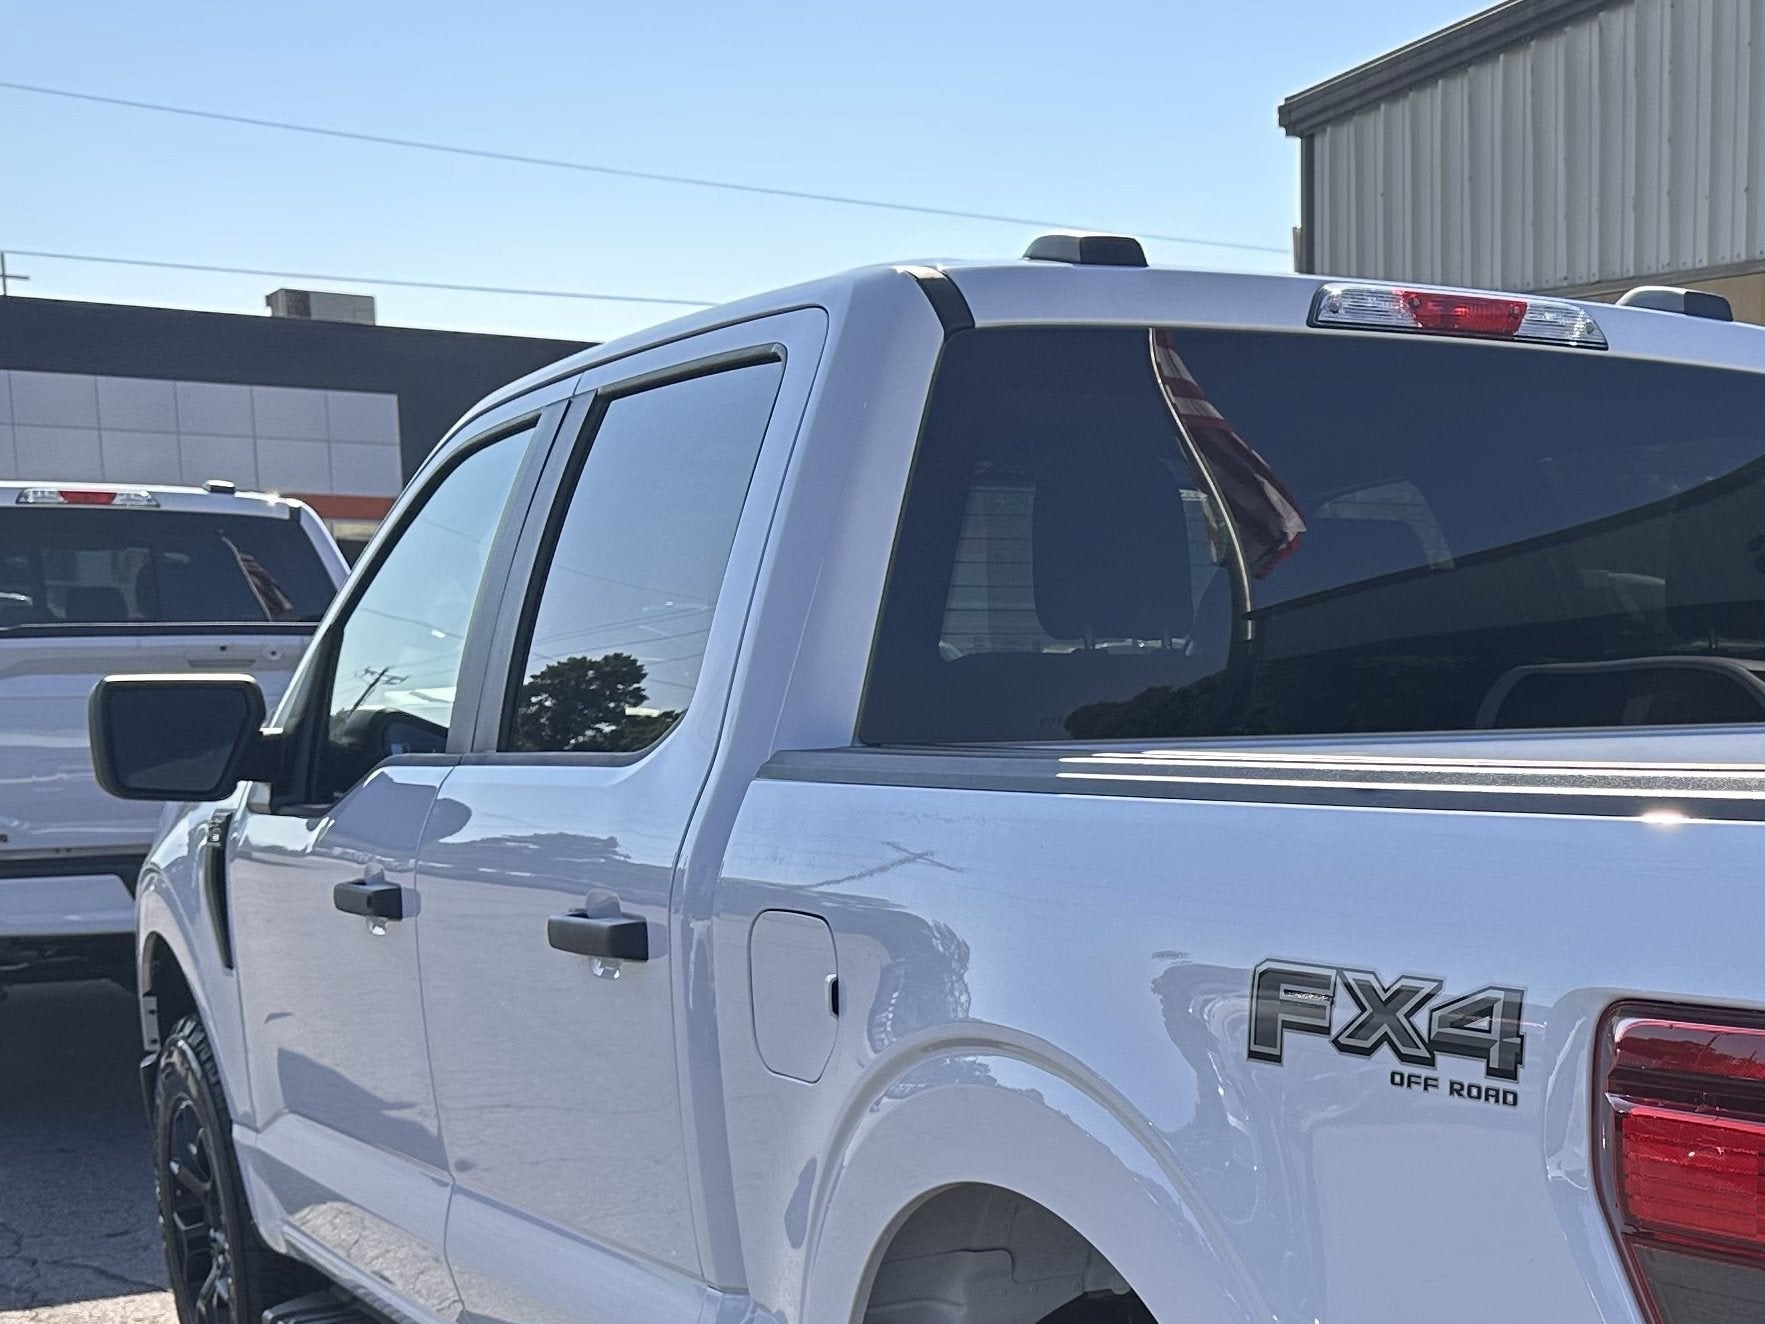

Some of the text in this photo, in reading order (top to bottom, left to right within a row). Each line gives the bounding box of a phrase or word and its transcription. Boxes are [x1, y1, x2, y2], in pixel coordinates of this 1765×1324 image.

[1246, 956, 1527, 1083] FX4
[1389, 1069, 1519, 1108] OFF ROAD
